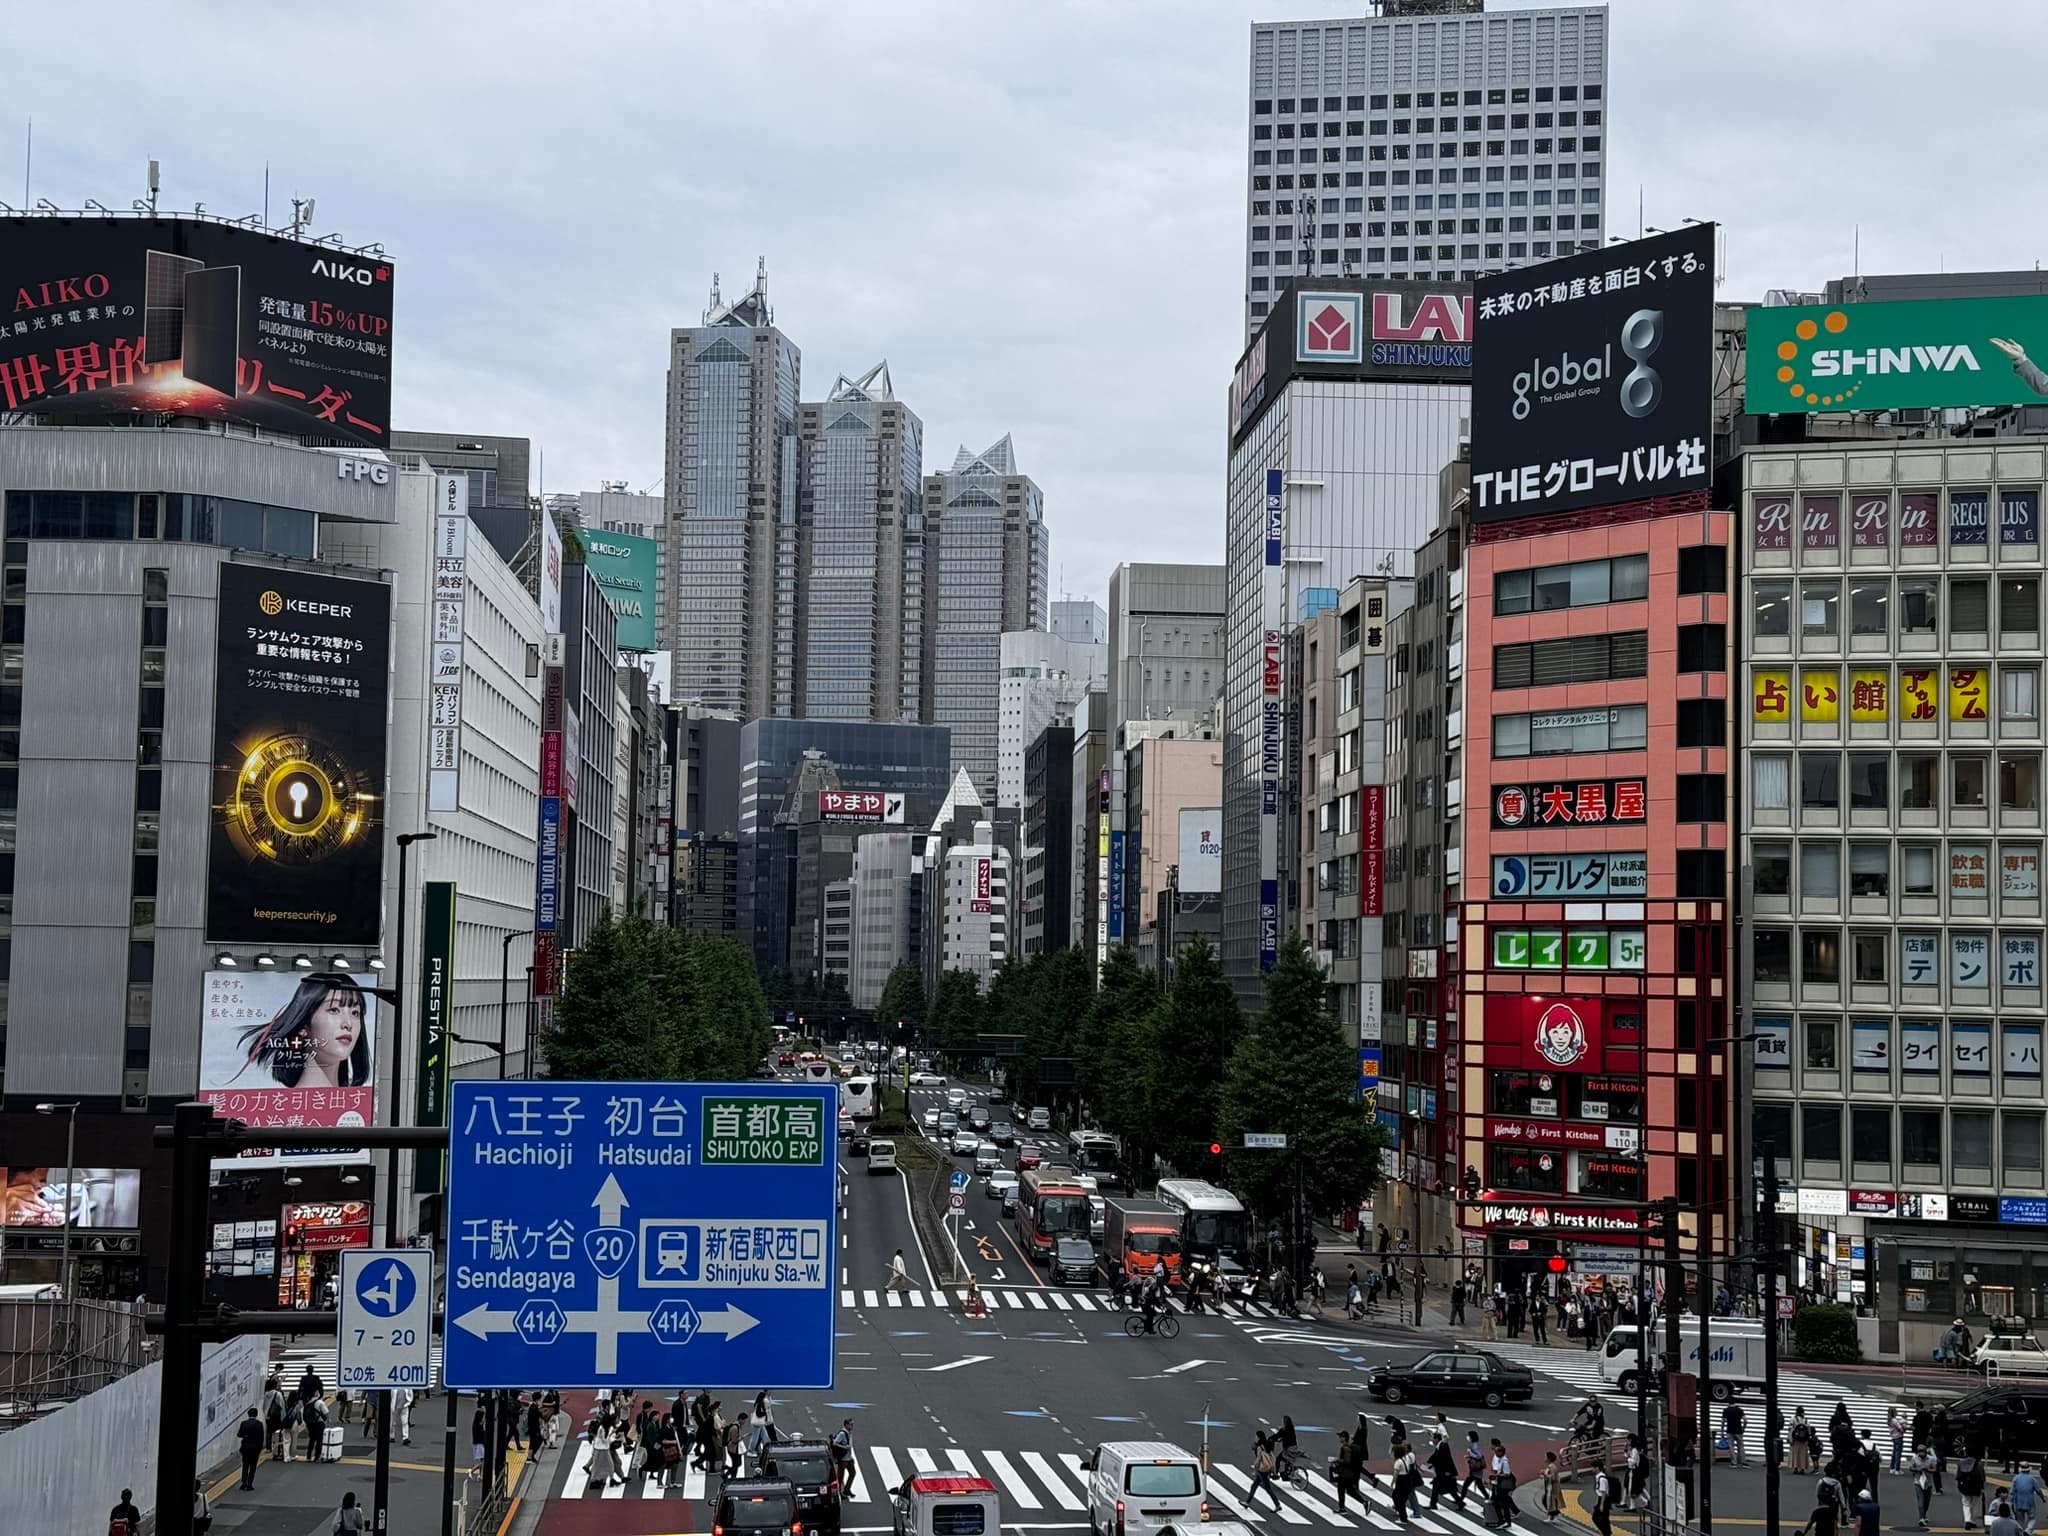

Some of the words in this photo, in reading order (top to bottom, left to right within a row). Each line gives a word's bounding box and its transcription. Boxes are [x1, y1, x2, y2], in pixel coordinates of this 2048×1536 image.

[312, 259, 373, 286] AIKO
[14, 273, 110, 313] AIKO
[1479, 252, 1706, 320] 未来の不動産を面白くする。
[0, 304, 135, 341] 太陽光発電業界の
[1373, 293, 1472, 342] LA
[258, 337, 307, 355] パネルより
[259, 320, 388, 357] 同設置面積で従来の太陽光
[1372, 344, 1472, 367] SHINJUKU
[1811, 345, 1981, 377] SHINWA
[1512, 344, 1611, 420] global
[1540, 395, 1552, 404] The
[1554, 390, 1576, 402] Global
[1578, 386, 1601, 398] Group
[338, 458, 389, 485] FPG
[1473, 437, 1706, 507] THEグローバル社
[1271, 510, 1281, 541] LABI
[590, 542, 631, 557] 美和ロック
[438, 560, 463, 573] 共立
[437, 576, 462, 589] 美容
[286, 599, 352, 618] KEEPER
[438, 603, 449, 640] 美容外科
[449, 615, 458, 634] 品川
[247, 627, 364, 651] ランサムウェア攻撃から
[256, 643, 350, 664] 重要な情報を守る！
[247, 669, 360, 687] サイバー攻撃から組織を保護する
[1265, 646, 1280, 696] LABI
[247, 679, 360, 698] シンプルで安全なパスワード管理
[434, 686, 459, 695] KEN
[435, 695, 444, 725] スクール
[447, 695, 457, 725] パソコン
[436, 730, 444, 767] クリニック
[1263, 702, 1279, 774] SHINJUKU
[825, 793, 880, 812] やまや
[1501, 792, 1524, 819] 質
[1542, 782, 1645, 823] 大黒屋
[543, 819, 556, 856] JAPAN
[1611, 860, 1646, 873] 人材派遣
[1952, 854, 1985, 870] 飲食
[2004, 856, 2036, 871] 専門
[542, 858, 555, 890] TOTAL
[1533, 858, 1607, 891] デルタ
[1611, 876, 1646, 887] 職業紹介
[1952, 873, 1985, 889] 転職
[254, 907, 337, 924] keepersecurity.jp
[541, 893, 555, 923] CLUB
[1265, 920, 1276, 950] LABI
[1509, 938, 1598, 963] レイク
[1620, 939, 1643, 962] 5F
[1905, 939, 1934, 953] 店舗
[1955, 940, 1985, 954] 物件
[2006, 940, 2035, 954] 検索
[211, 979, 245, 990] 生やす。
[211, 993, 244, 1004] 生きる。
[210, 1008, 268, 1019] 私を、生きる。
[266, 1037, 290, 1048] AGA
[304, 1038, 329, 1048] スキン
[278, 1050, 317, 1061] クリニック
[1587, 1081, 1608, 1090] First
[208, 1090, 367, 1113] 髪の力を引き出す
[465, 1096, 584, 1136] 八王子
[604, 1096, 687, 1137] 初台
[710, 1104, 816, 1138] 首都高
[1494, 1123, 1522, 1138] Wendy's
[1541, 1129, 1561, 1138] First
[1566, 1130, 1599, 1141] Kitchen
[475, 1143, 573, 1169] Hachioji
[599, 1143, 692, 1167] Hatsudai
[707, 1141, 784, 1159] SHUTOKO
[789, 1142, 819, 1160] EXP
[1587, 1162, 1608, 1172] First
[293, 1205, 342, 1220] ナポリタン
[1957, 1202, 1990, 1210] STRAIL
[1554, 1212, 1585, 1227] First
[595, 1236, 623, 1261] 20
[705, 1227, 821, 1261] 新宿駅西口
[456, 1266, 576, 1292] Sendagaya
[705, 1263, 769, 1283] Shinjuku
[774, 1263, 821, 1282] Sta.-W.
[523, 1311, 557, 1332] 414
[657, 1311, 692, 1332] 414
[343, 1366, 375, 1382] この先
[388, 1365, 424, 1382] 40m
